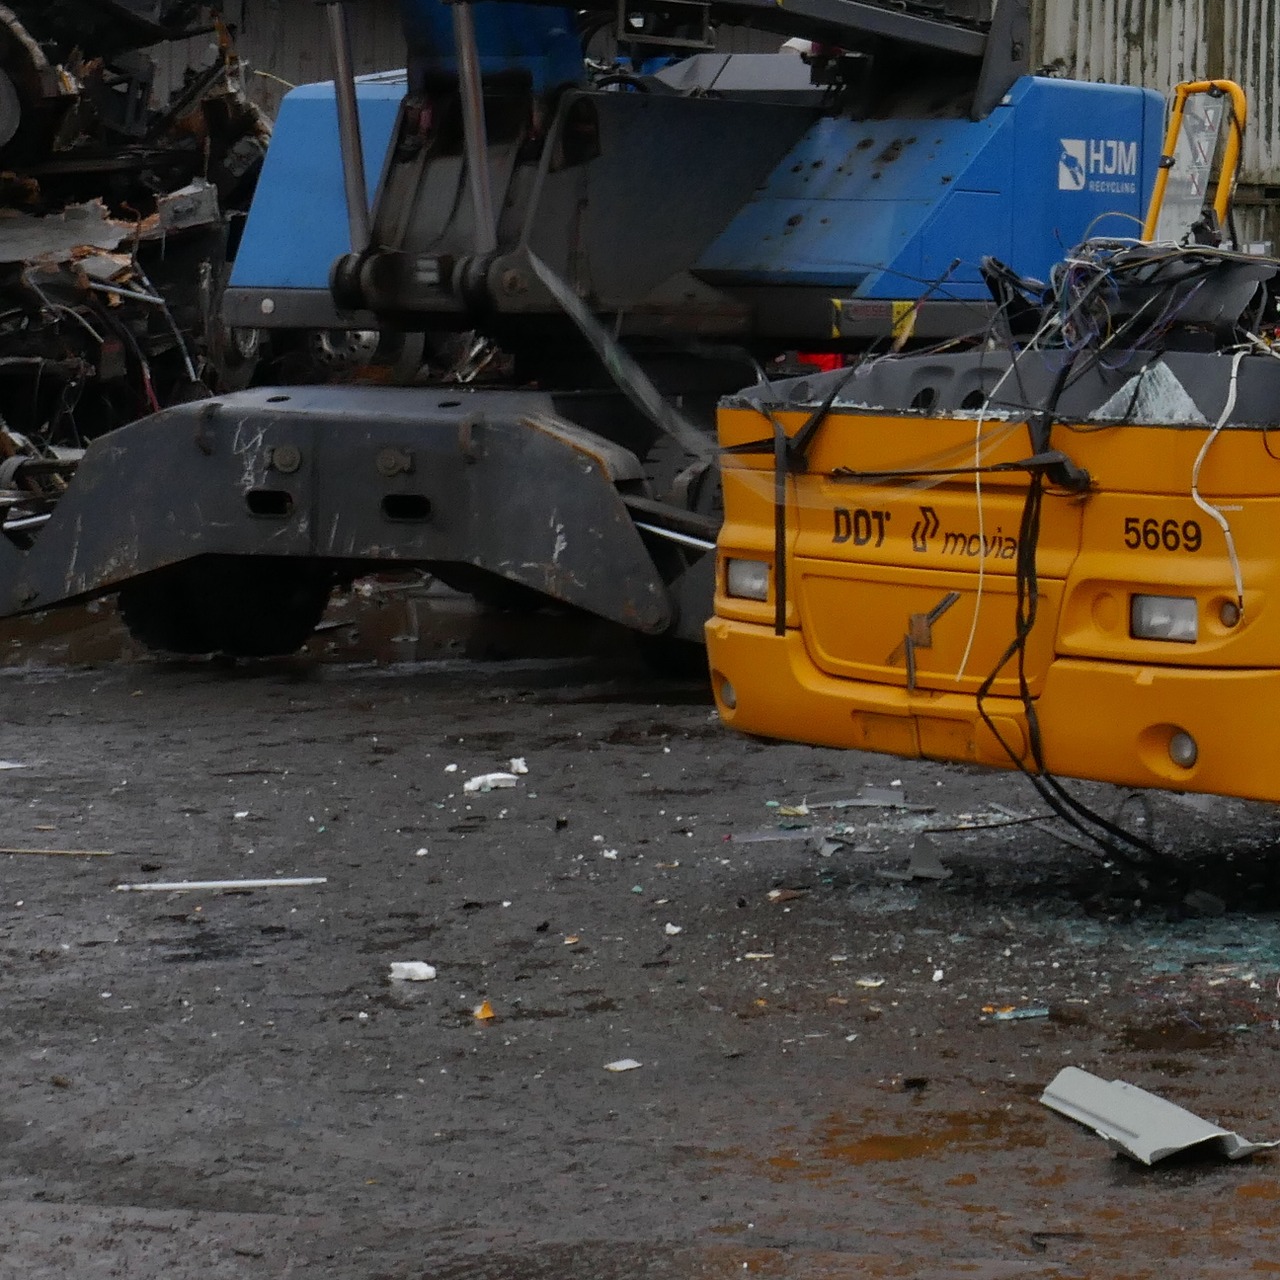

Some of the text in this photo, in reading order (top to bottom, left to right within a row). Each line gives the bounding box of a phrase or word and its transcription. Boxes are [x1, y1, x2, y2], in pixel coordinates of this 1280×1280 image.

[1089, 139, 1137, 175] HJM
[1088, 180, 1136, 194] RECYCLING
[941, 527, 1018, 560] movia
[1124, 517, 1202, 552] 5669
